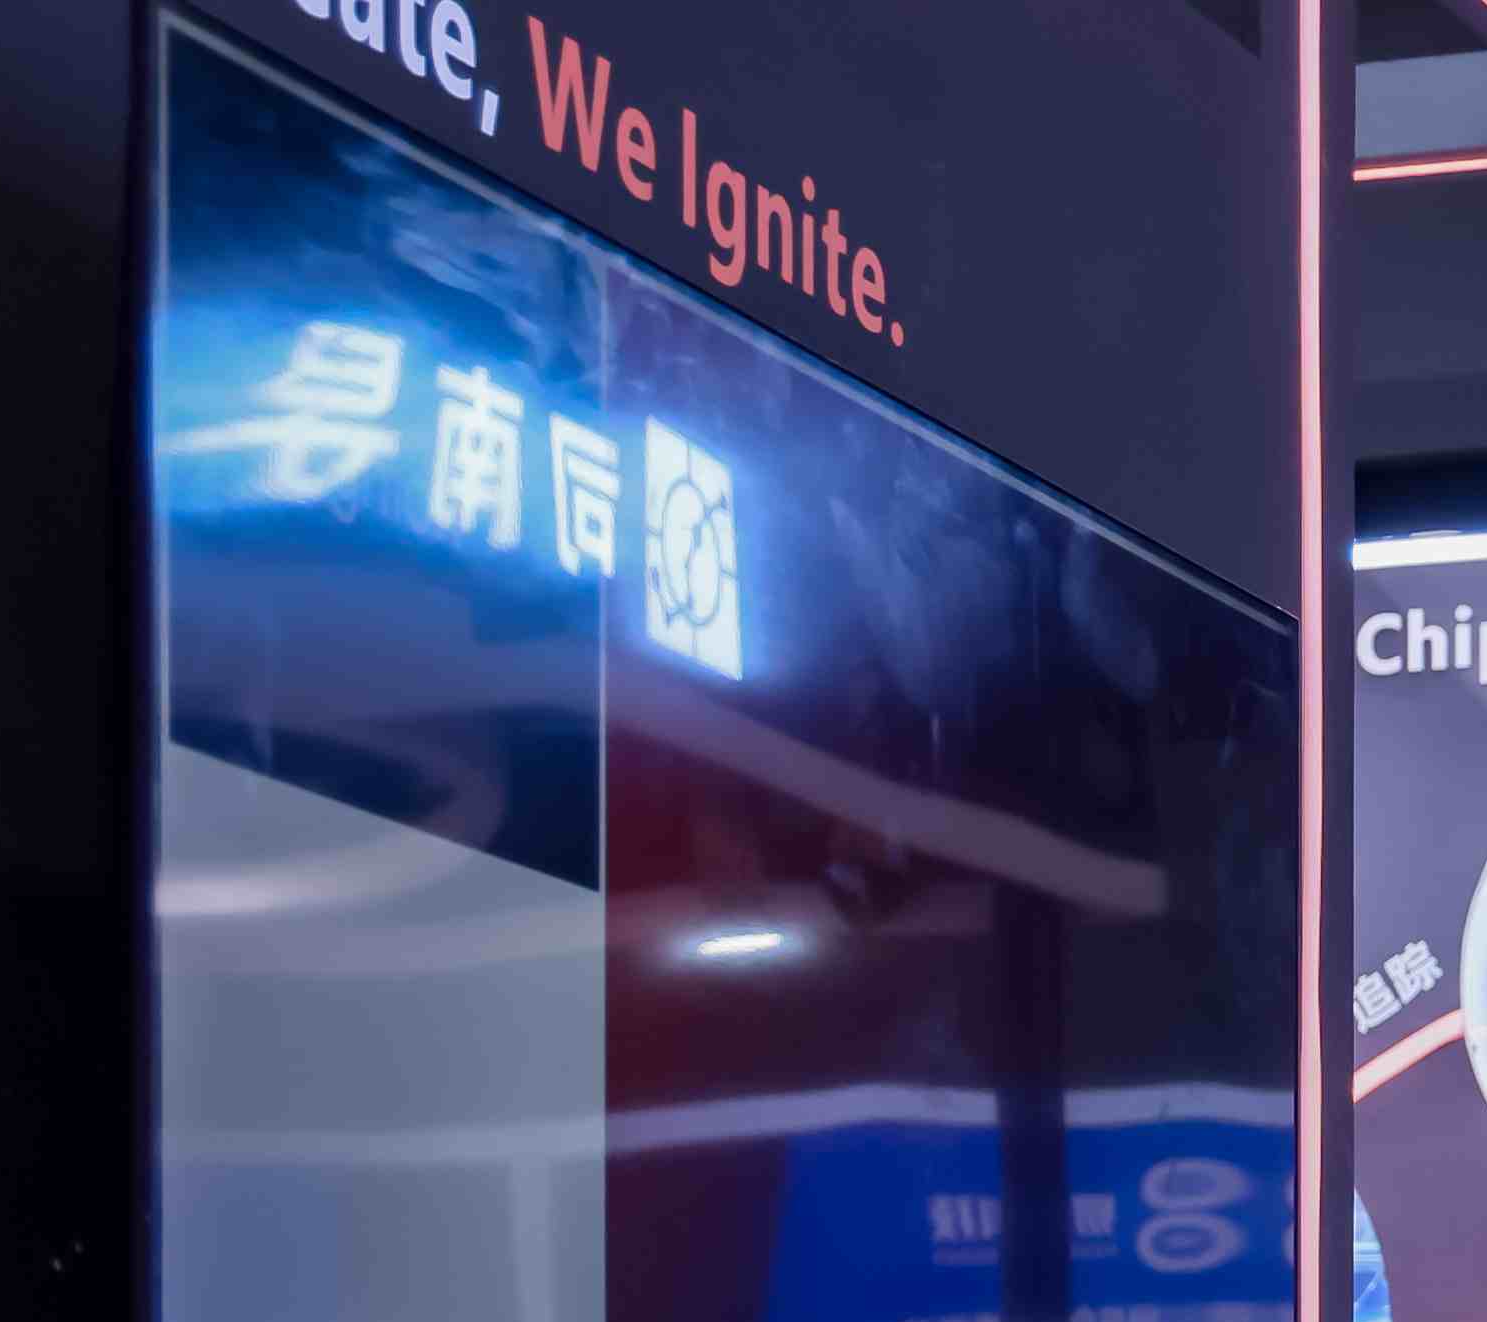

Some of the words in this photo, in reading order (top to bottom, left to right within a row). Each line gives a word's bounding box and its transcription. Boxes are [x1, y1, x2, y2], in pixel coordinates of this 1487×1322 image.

[294, 0, 500, 137] ate,
[527, 14, 656, 201] We
[681, 108, 905, 348] Ignite.
[1353, 939, 1444, 1035] 追踪
